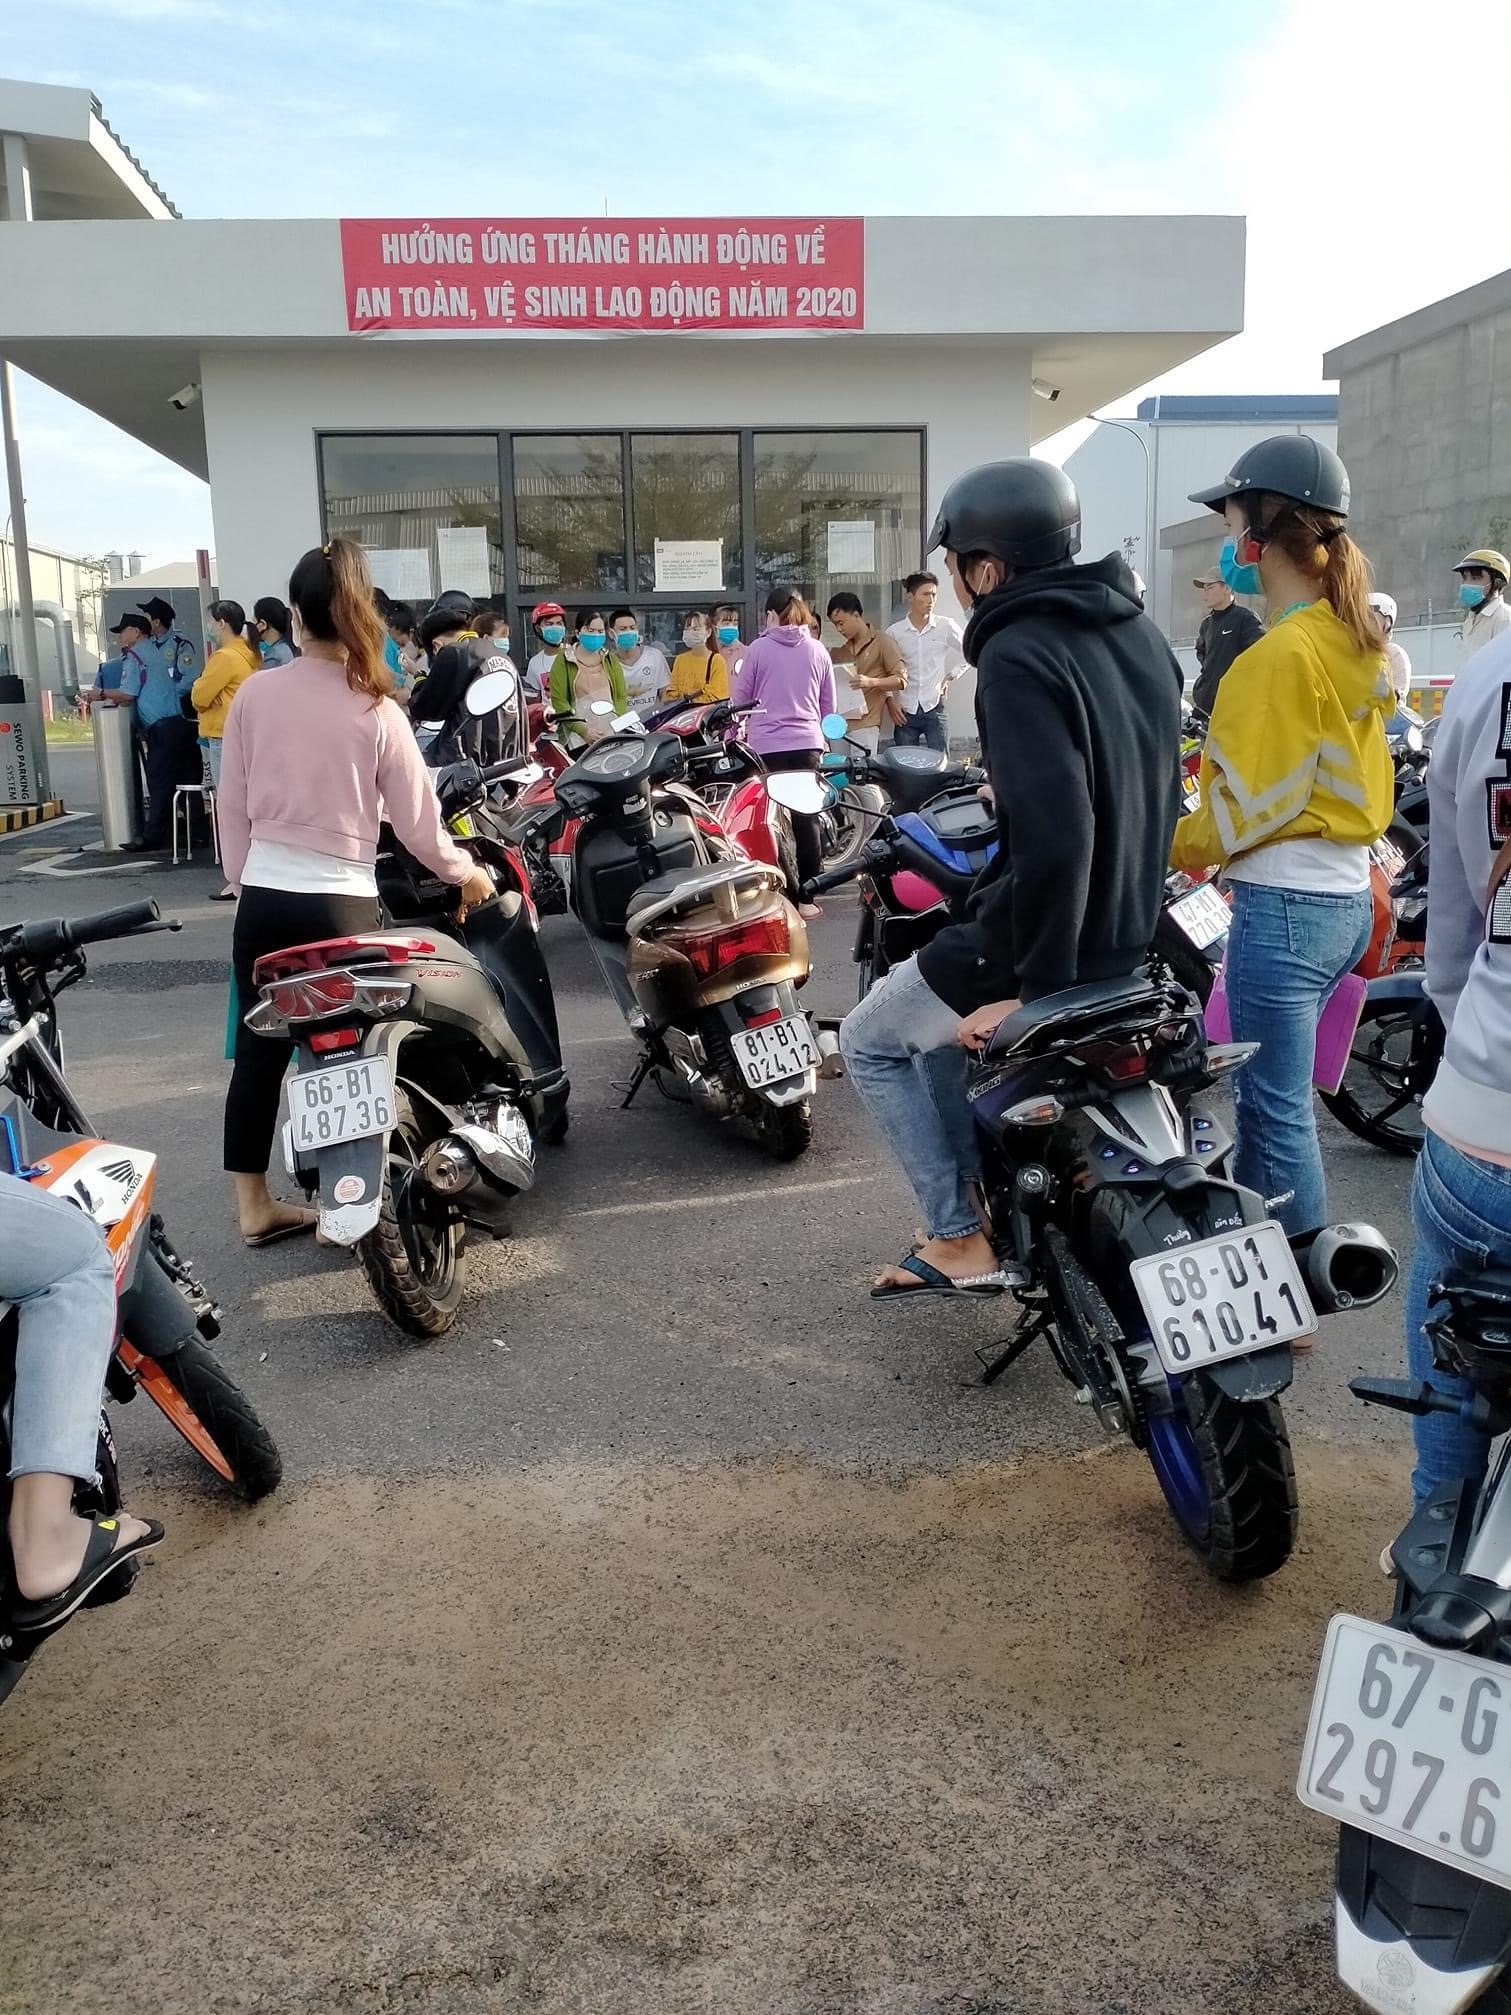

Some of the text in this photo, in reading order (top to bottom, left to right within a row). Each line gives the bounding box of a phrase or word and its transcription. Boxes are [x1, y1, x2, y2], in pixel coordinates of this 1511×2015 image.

[381, 223, 826, 271] HƯỞNG ỨNG THÁNG HÀNH ĐỘNG VỀ
[354, 280, 858, 324] AN TOÀN, VỆ SINH LAO ĐỘNG NĂM 2020
[6, 764, 18, 801] SYSTEM
[13, 722, 30, 800] SEWO PARKING
[416, 969, 463, 978] VISION
[323, 1049, 357, 1060] HONDA
[745, 1020, 799, 1057] 81-B1
[747, 1043, 816, 1084] 024.12
[304, 1065, 373, 1109] 66-B1
[301, 1096, 390, 1143] 487.36
[120, 1172, 143, 1205] HONDA
[1158, 1236, 1269, 1307] 68-D1
[1162, 1282, 1304, 1362] 610.41
[1358, 1642, 1511, 1756] 67-G
[1315, 1721, 1504, 1859] 297.6
